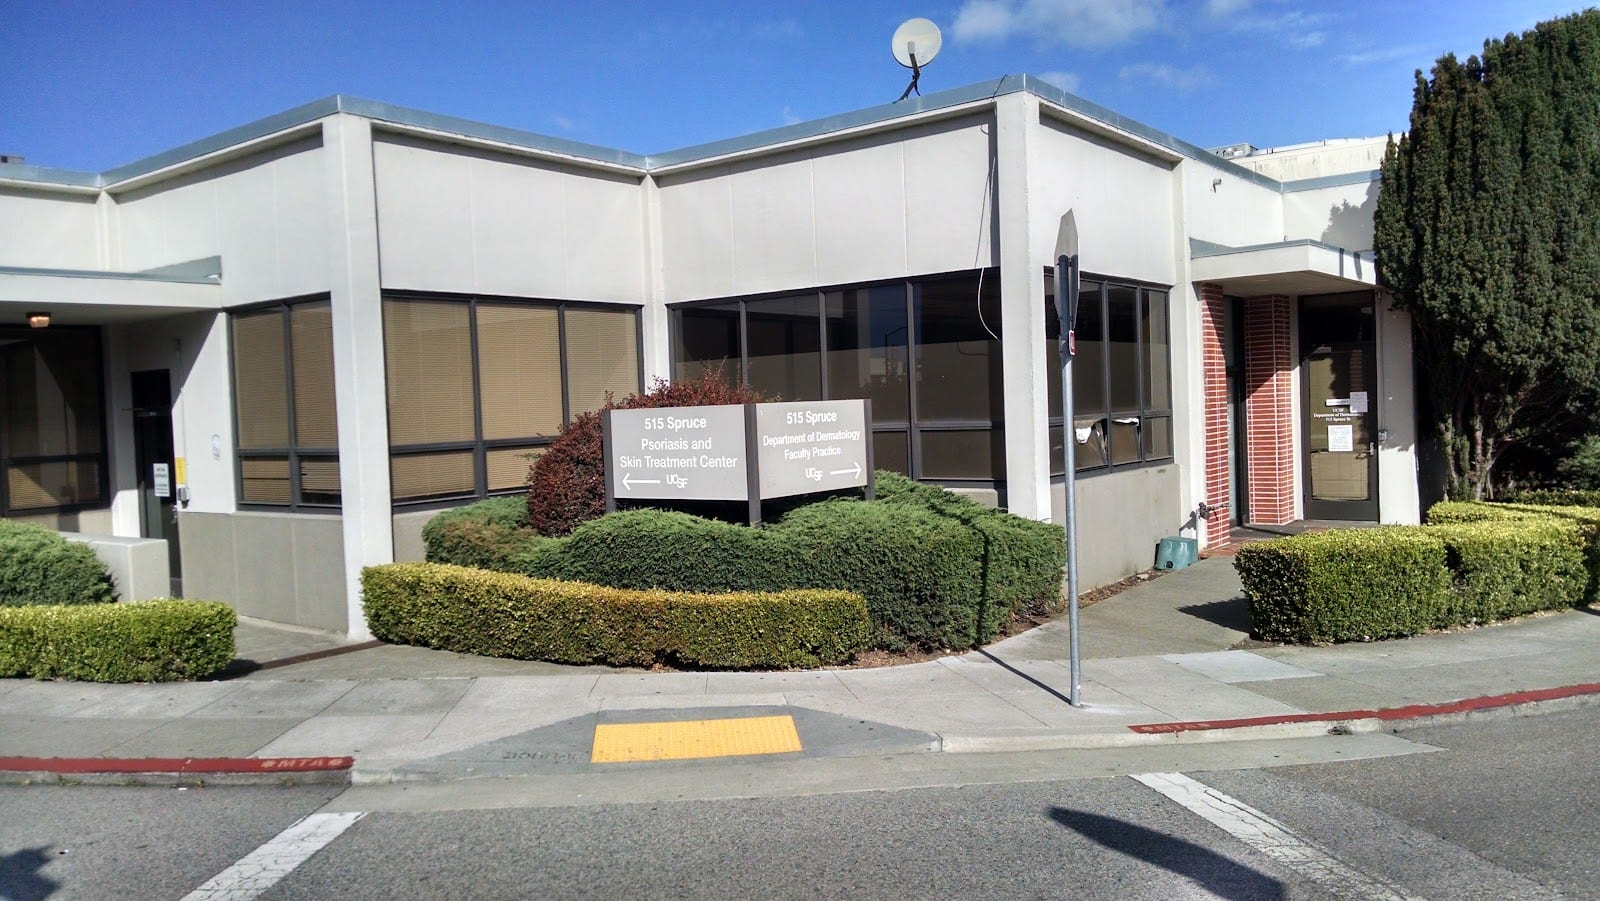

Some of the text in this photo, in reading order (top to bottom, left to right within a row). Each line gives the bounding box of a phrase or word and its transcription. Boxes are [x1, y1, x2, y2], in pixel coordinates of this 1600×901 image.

[644, 416, 707, 432] 515 Spruce
[786, 410, 837, 426] 515 Spruce
[641, 437, 712, 450] Psoriasis and
[763, 430, 861, 448] Department of Dermatology
[784, 446, 841, 461] Faculty Practice
[620, 455, 738, 468] Skin Treatment Center
